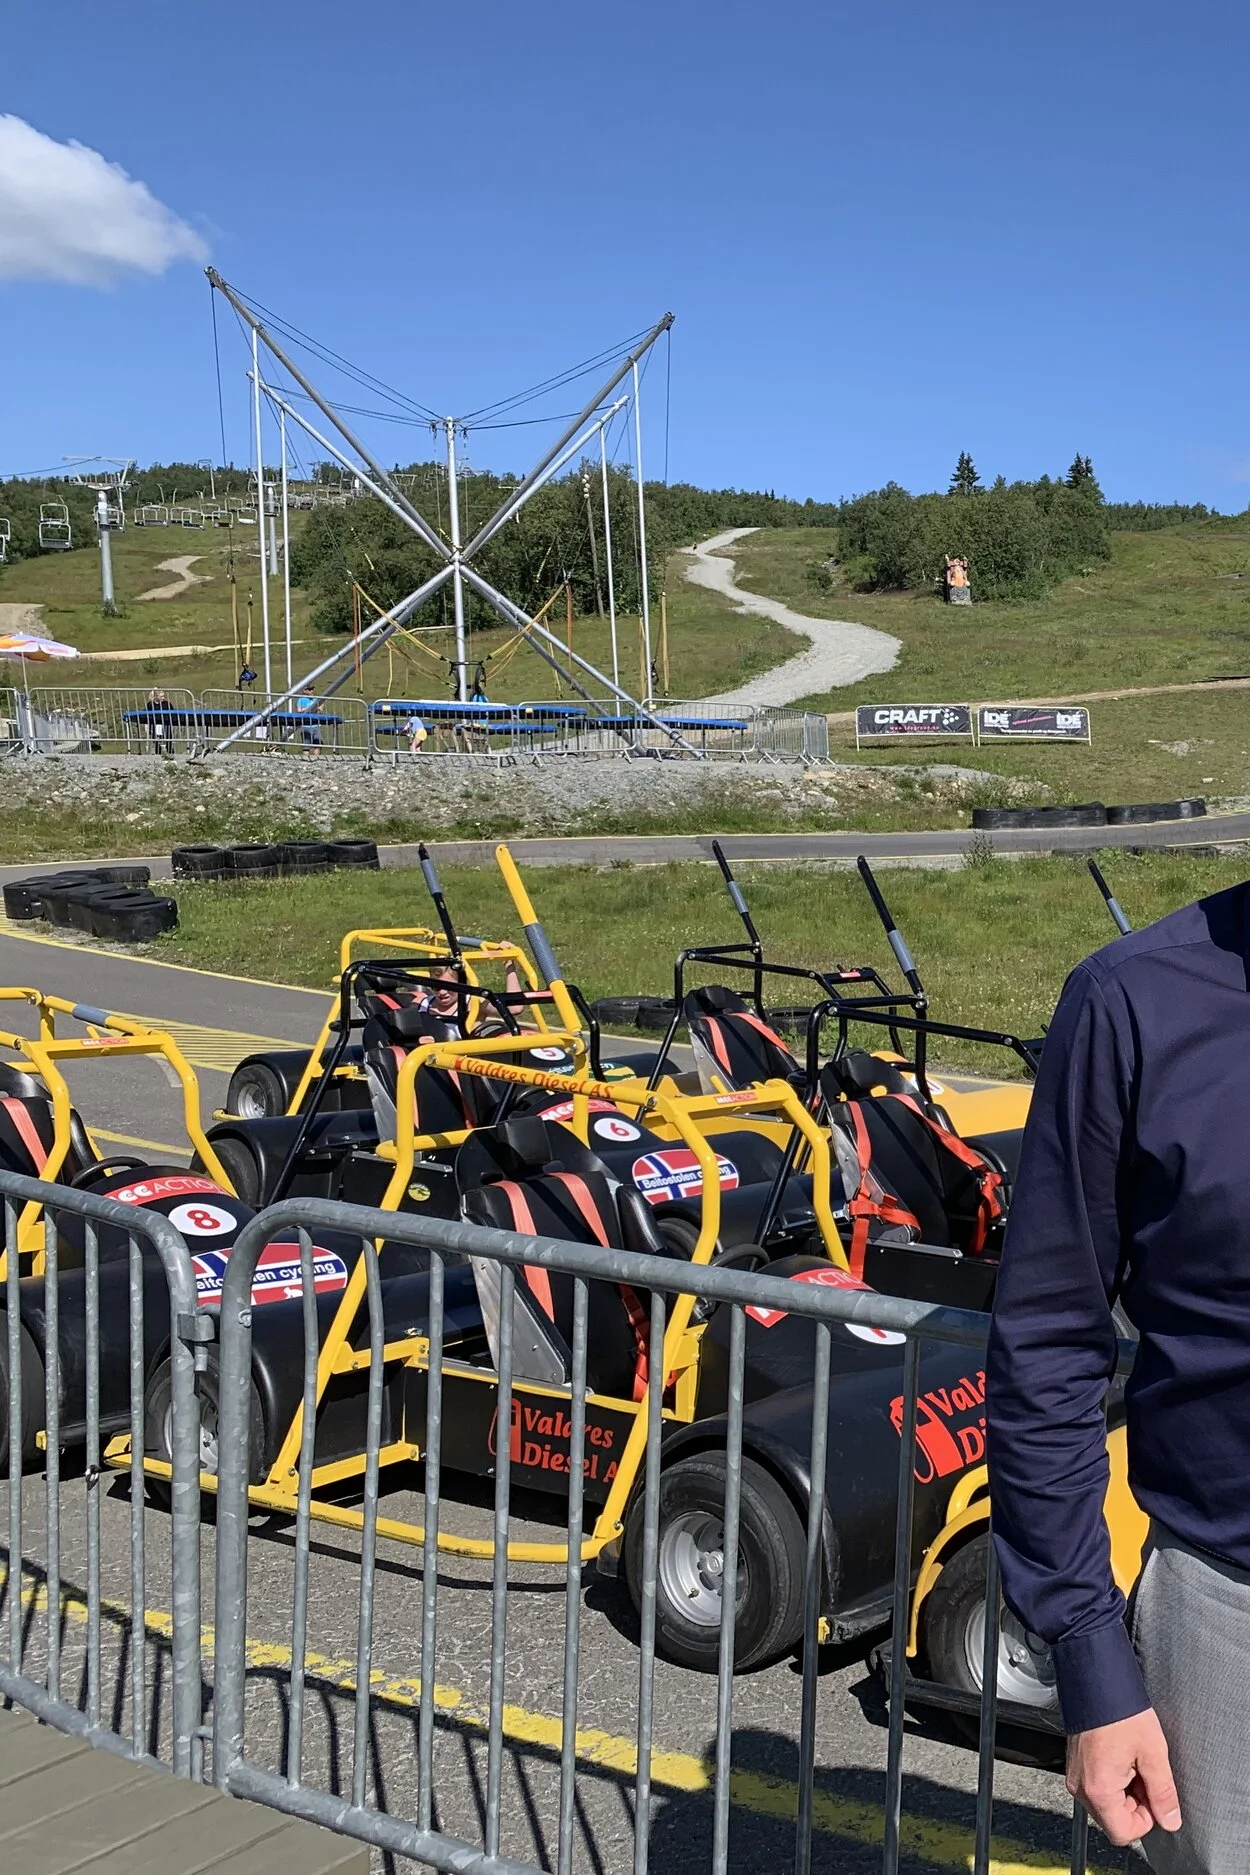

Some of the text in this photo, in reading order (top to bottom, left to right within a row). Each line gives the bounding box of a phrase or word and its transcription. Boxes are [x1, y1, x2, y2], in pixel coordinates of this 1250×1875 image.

[874, 709, 942, 724] CRAFT
[465, 1059, 527, 1084] Valdres
[532, 1073, 586, 1094] Diesel
[590, 1083, 615, 1100] AS
[608, 1122, 630, 1137] 6
[187, 1209, 220, 1230] 8
[603, 1461, 619, 1483] A
